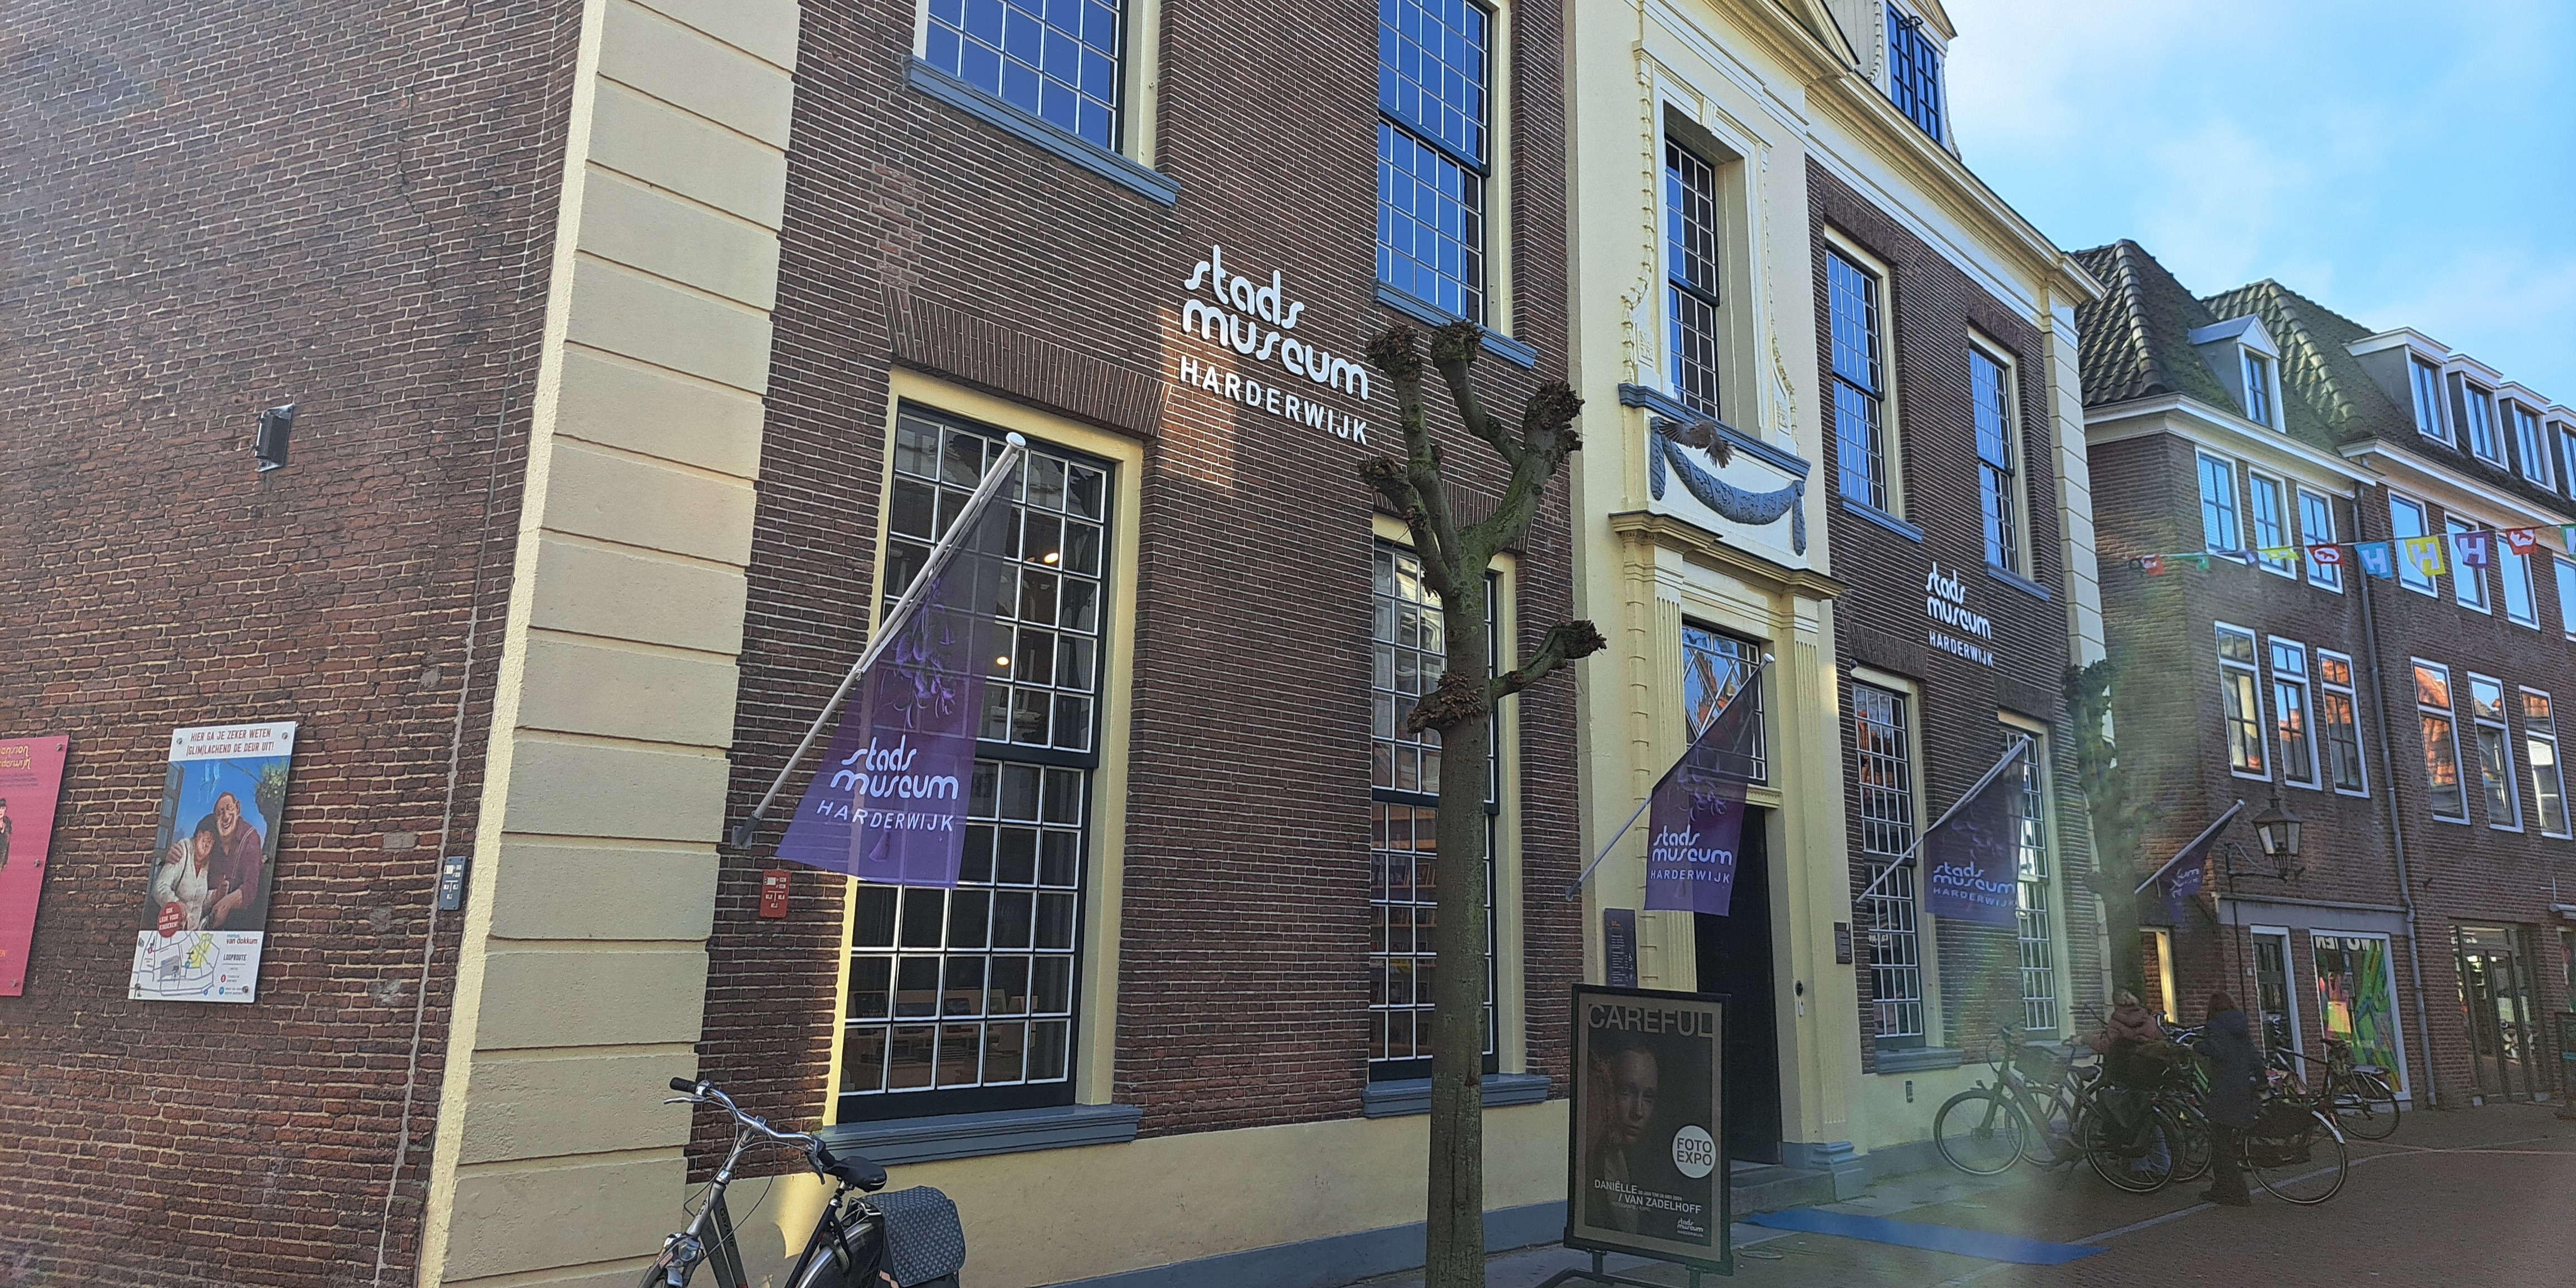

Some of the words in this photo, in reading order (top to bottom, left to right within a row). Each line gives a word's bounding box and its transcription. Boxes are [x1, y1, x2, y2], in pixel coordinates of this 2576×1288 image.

[1184, 244, 1304, 329] stads
[1182, 299, 1368, 400] museum
[1180, 355, 1367, 445] HARDERWIJK
[1925, 561, 1965, 604] stads
[1927, 596, 1992, 640] museum
[1929, 630, 1994, 668] HARDERWIJK
[191, 732, 204, 741] HIER
[207, 731, 214, 740] GA
[217, 731, 225, 740] JE
[227, 729, 246, 739] ZEKER
[250, 728, 271, 738] WETEN
[233, 743, 241, 752] DE
[244, 743, 259, 752] DEUR
[262, 741, 274, 750] UIT!
[841, 734, 917, 772] stads
[830, 769, 959, 800] museum
[816, 799, 954, 832] HARDERWIJK
[1653, 824, 1700, 846] stads
[1652, 848, 1732, 866] museum
[1651, 870, 1730, 884] HARDERWIJK
[1933, 861, 1985, 877] stads
[1933, 874, 2016, 894] museum
[1588, 1003, 1713, 1038] CAREFUL
[1677, 1137, 1712, 1153] FOTO
[1677, 1150, 1712, 1166] EXPO
[1594, 1179, 1638, 1194] DANIËLLE
[1624, 1194, 1643, 1206] VAN
[1646, 1197, 1702, 1214] ZADELHOFF
